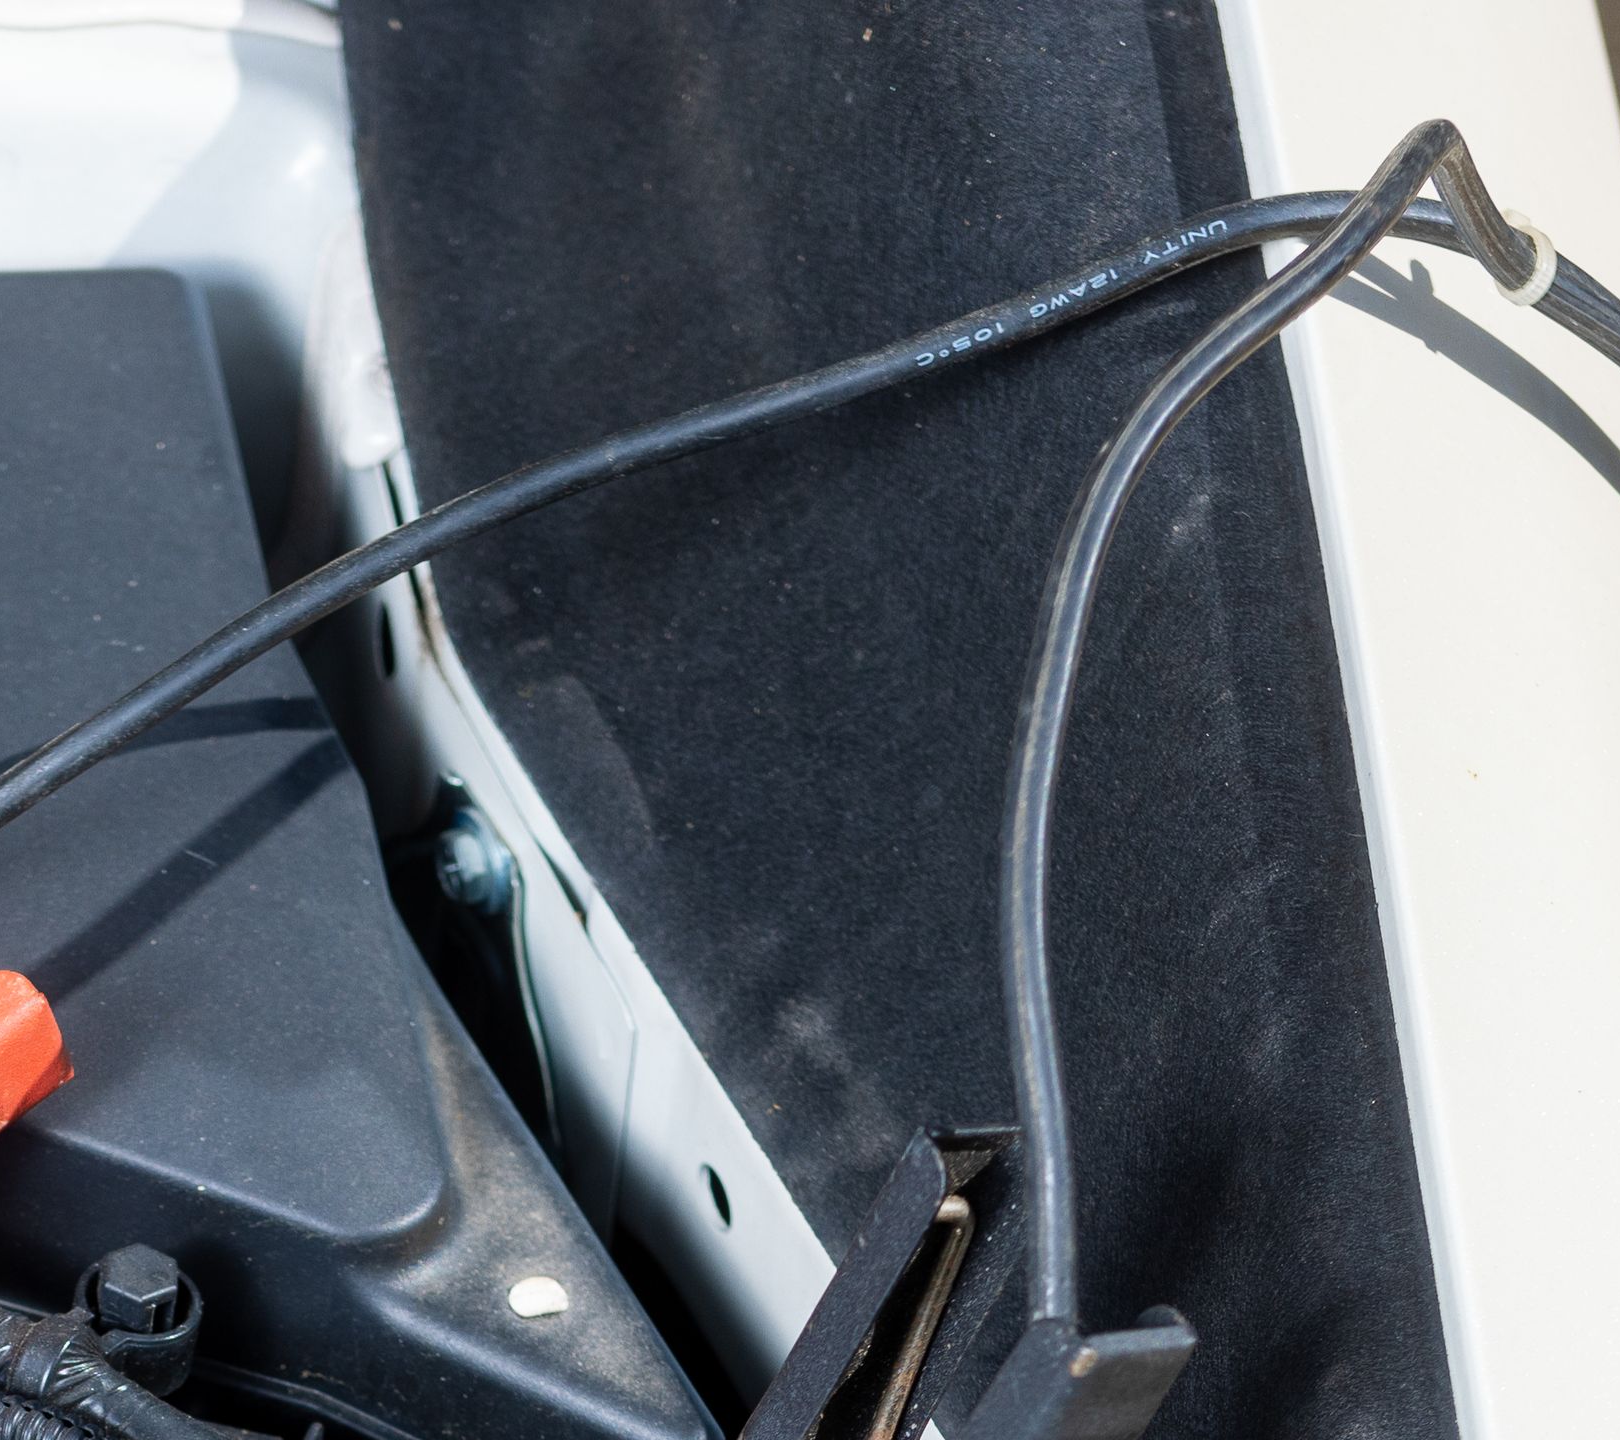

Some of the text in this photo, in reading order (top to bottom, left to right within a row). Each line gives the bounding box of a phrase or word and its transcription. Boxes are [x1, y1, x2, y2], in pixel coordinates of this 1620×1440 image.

[915, 219, 1227, 367] UNITY 12AWG 105°C
